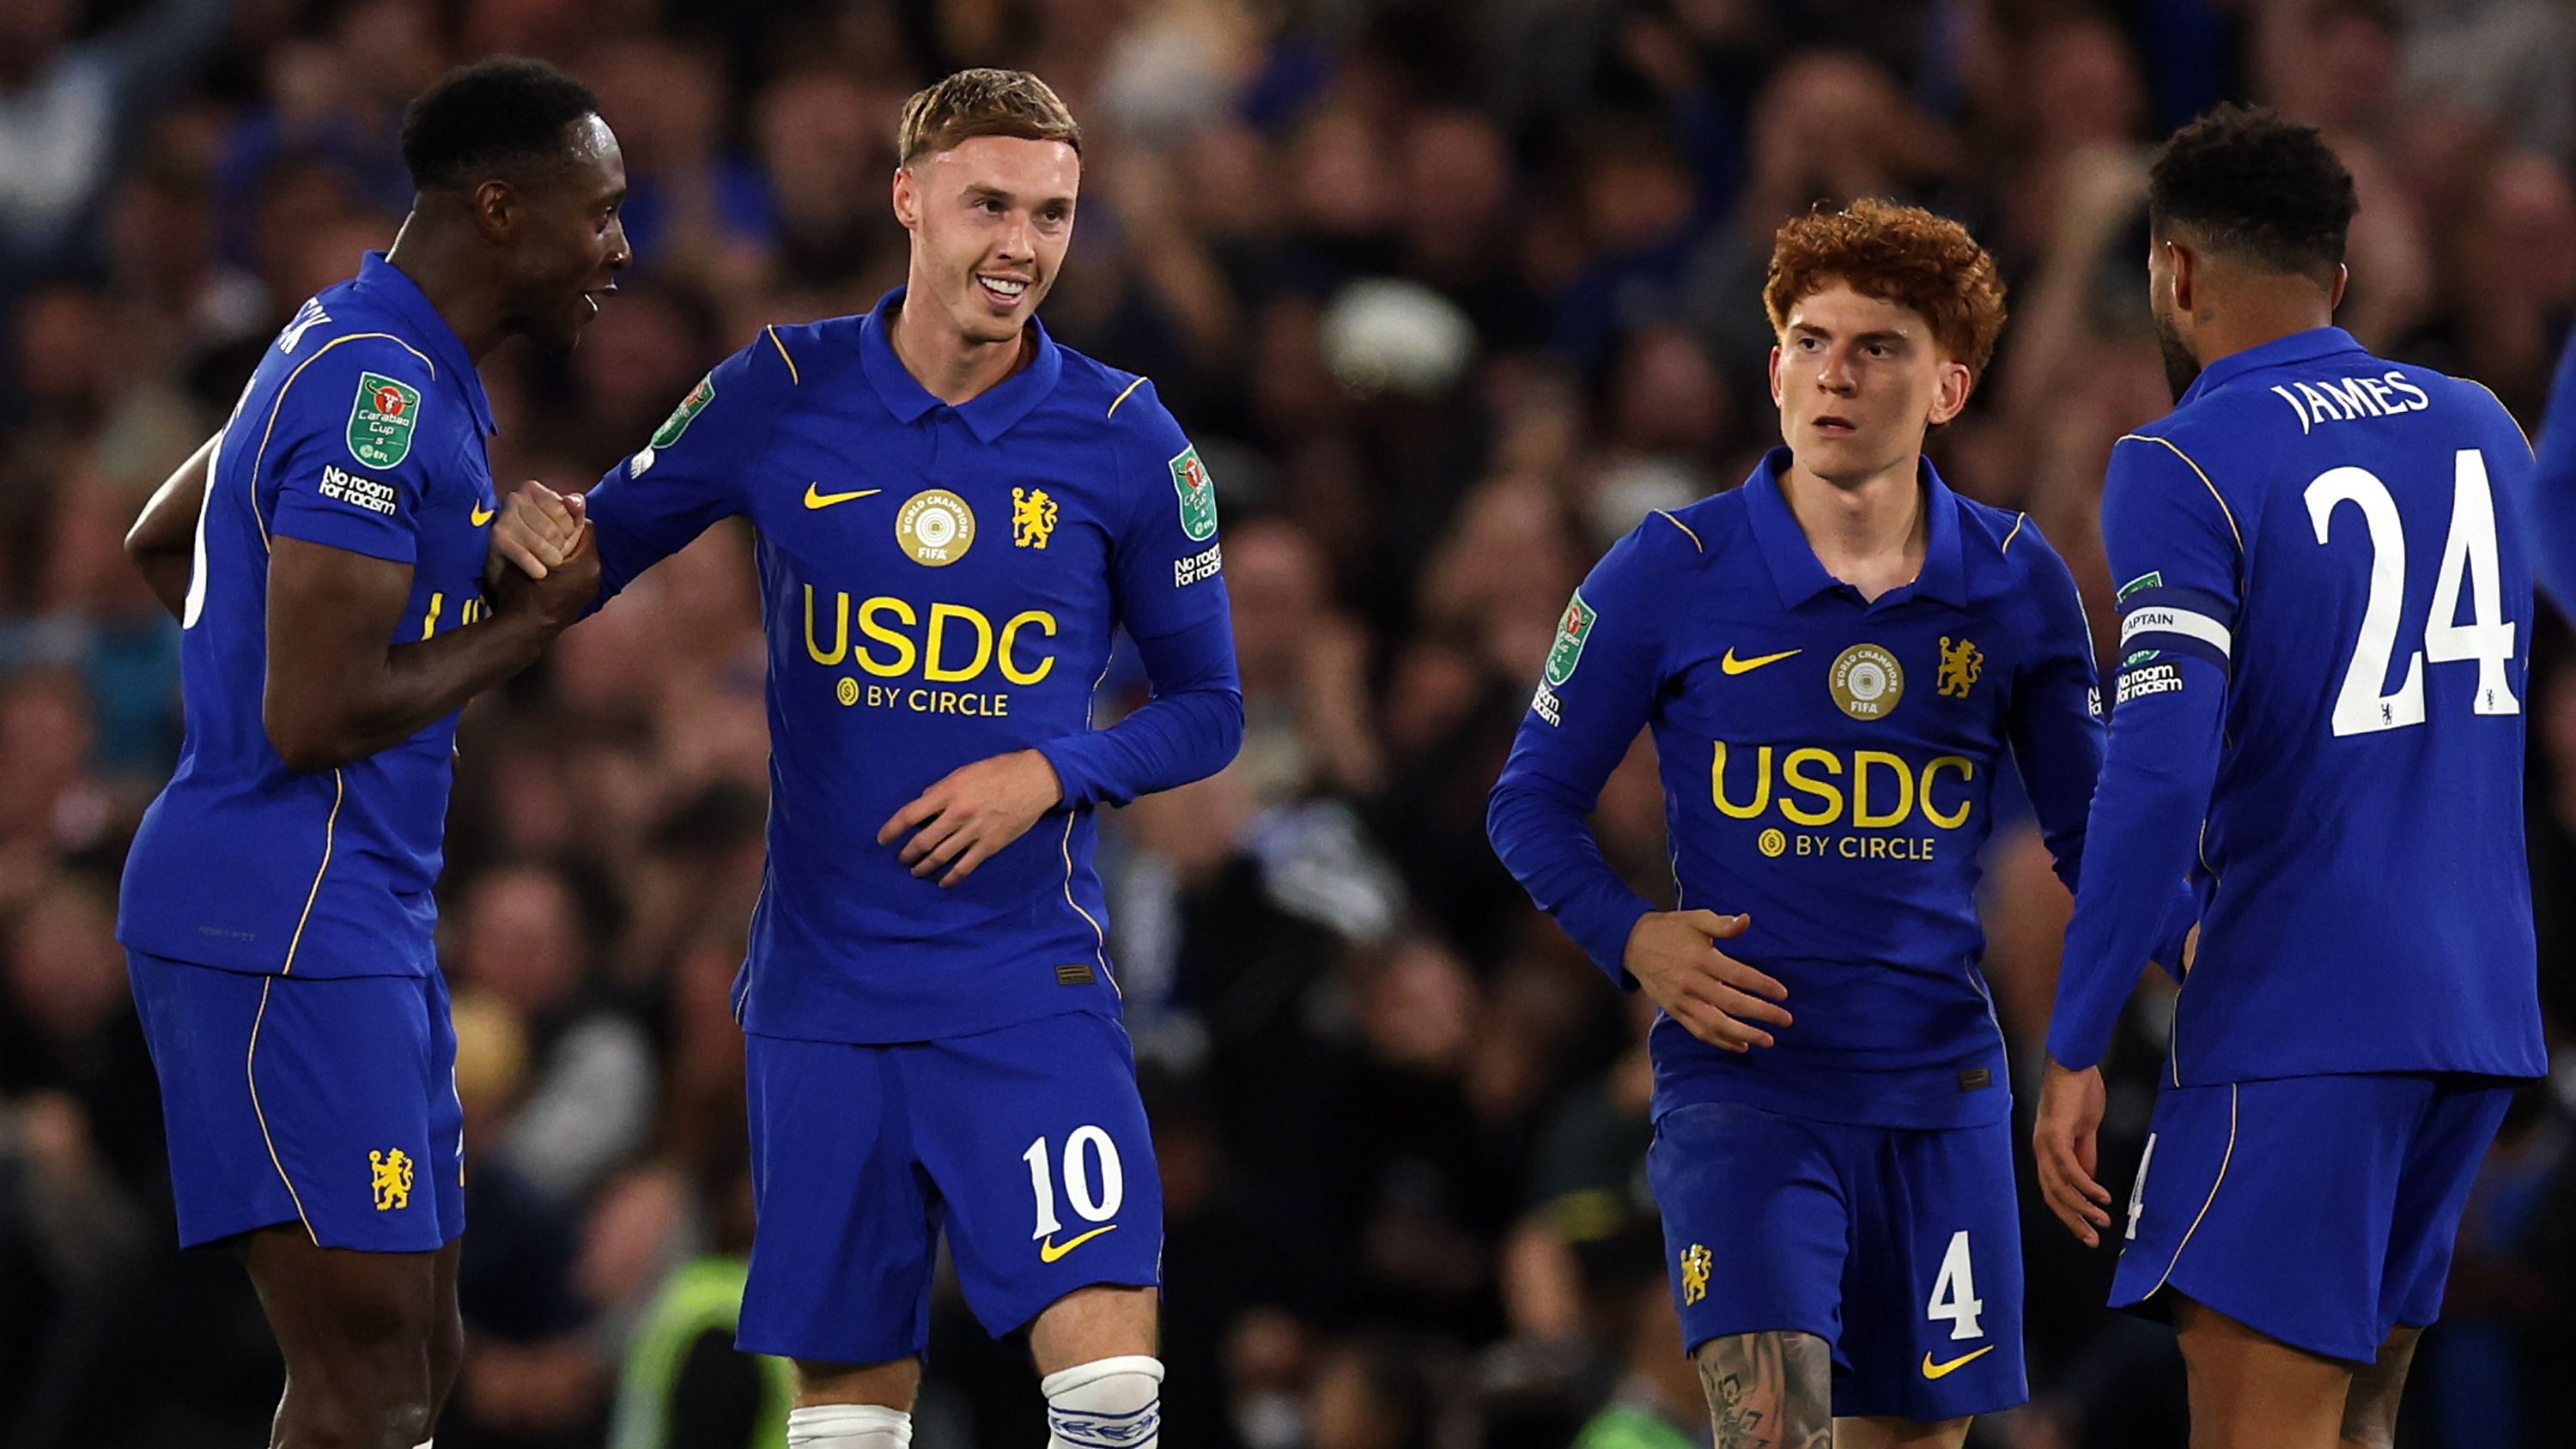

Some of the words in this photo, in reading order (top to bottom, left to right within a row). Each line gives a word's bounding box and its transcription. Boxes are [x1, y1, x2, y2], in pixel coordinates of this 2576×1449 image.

[2271, 371, 2429, 434] JAMES
[358, 409, 410, 427] Carabao
[369, 421, 394, 435] Cup
[373, 450, 388, 463] EFL
[325, 464, 349, 486] No
[349, 476, 394, 500] room
[319, 479, 344, 499] for
[343, 488, 396, 516] racism
[903, 500, 926, 534] WORLD
[927, 495, 969, 539] CHAMPIONS
[917, 547, 948, 560] FIFA
[1175, 557, 1195, 573] No
[2304, 449, 2520, 737] 24
[804, 583, 1056, 685] USDC
[2124, 613, 2174, 634] CAPTAIN
[1837, 654, 1856, 688] WORLD
[1857, 651, 1898, 693] CHAMPIONS
[2131, 665, 2173, 685] room
[867, 685, 901, 708] BY
[908, 689, 1008, 716] CIRCLE
[2088, 686, 2101, 701] N
[2131, 678, 2183, 700] racism
[1850, 700, 1878, 713] FIFA
[1711, 740, 1972, 829] USDC
[1795, 835, 1830, 857] BY
[1838, 837, 1935, 860] CIRCLE
[1023, 1125, 1123, 1240] 10
[1928, 1230, 1984, 1340] 4
